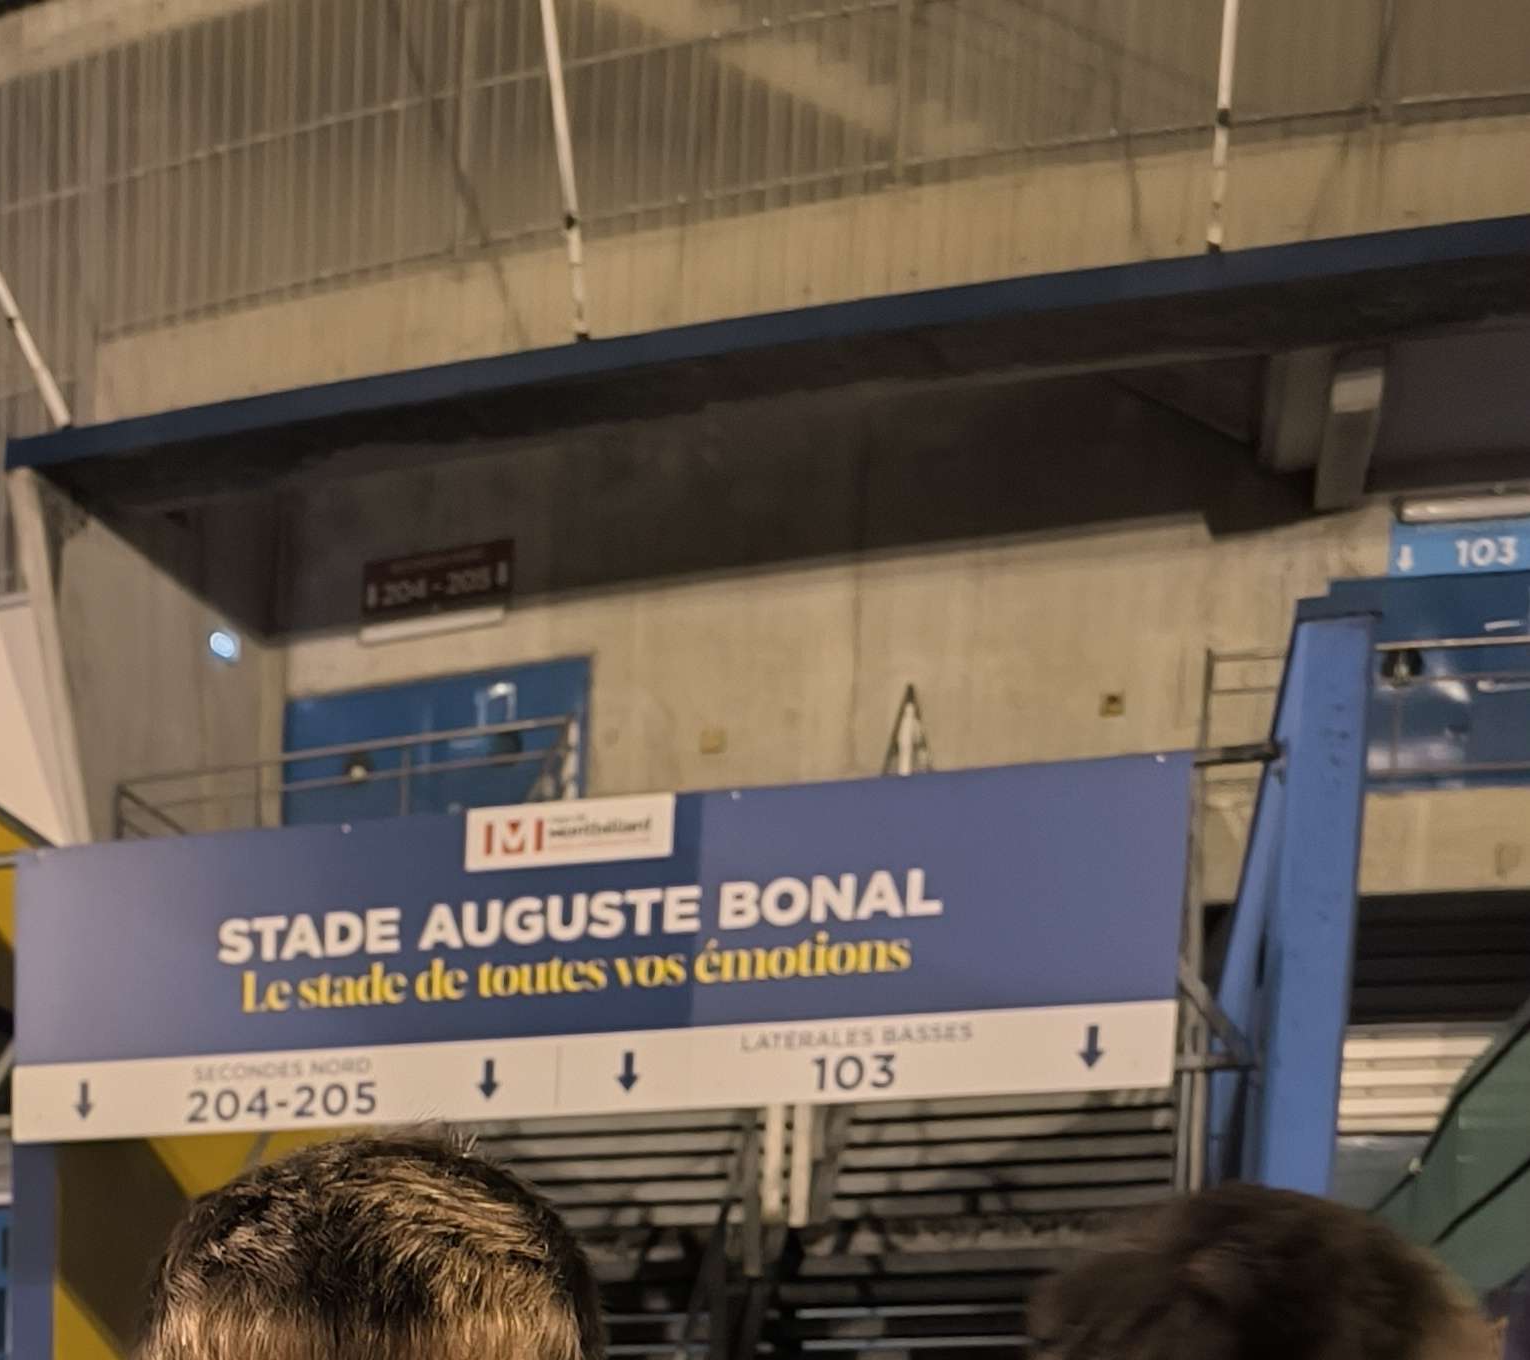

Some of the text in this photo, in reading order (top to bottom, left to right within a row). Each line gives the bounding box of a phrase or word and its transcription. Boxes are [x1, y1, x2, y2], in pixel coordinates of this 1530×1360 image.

[1455, 536, 1517, 567] 103
[218, 868, 943, 964] STADE AUGUSTE BONAL
[242, 931, 912, 1013] Le stade de toutes vos émotions
[882, 1021, 974, 1044] BASSES
[194, 1056, 370, 1082] SECONDES NORD
[812, 1053, 897, 1091] 103
[186, 1081, 376, 1123] 204-205
